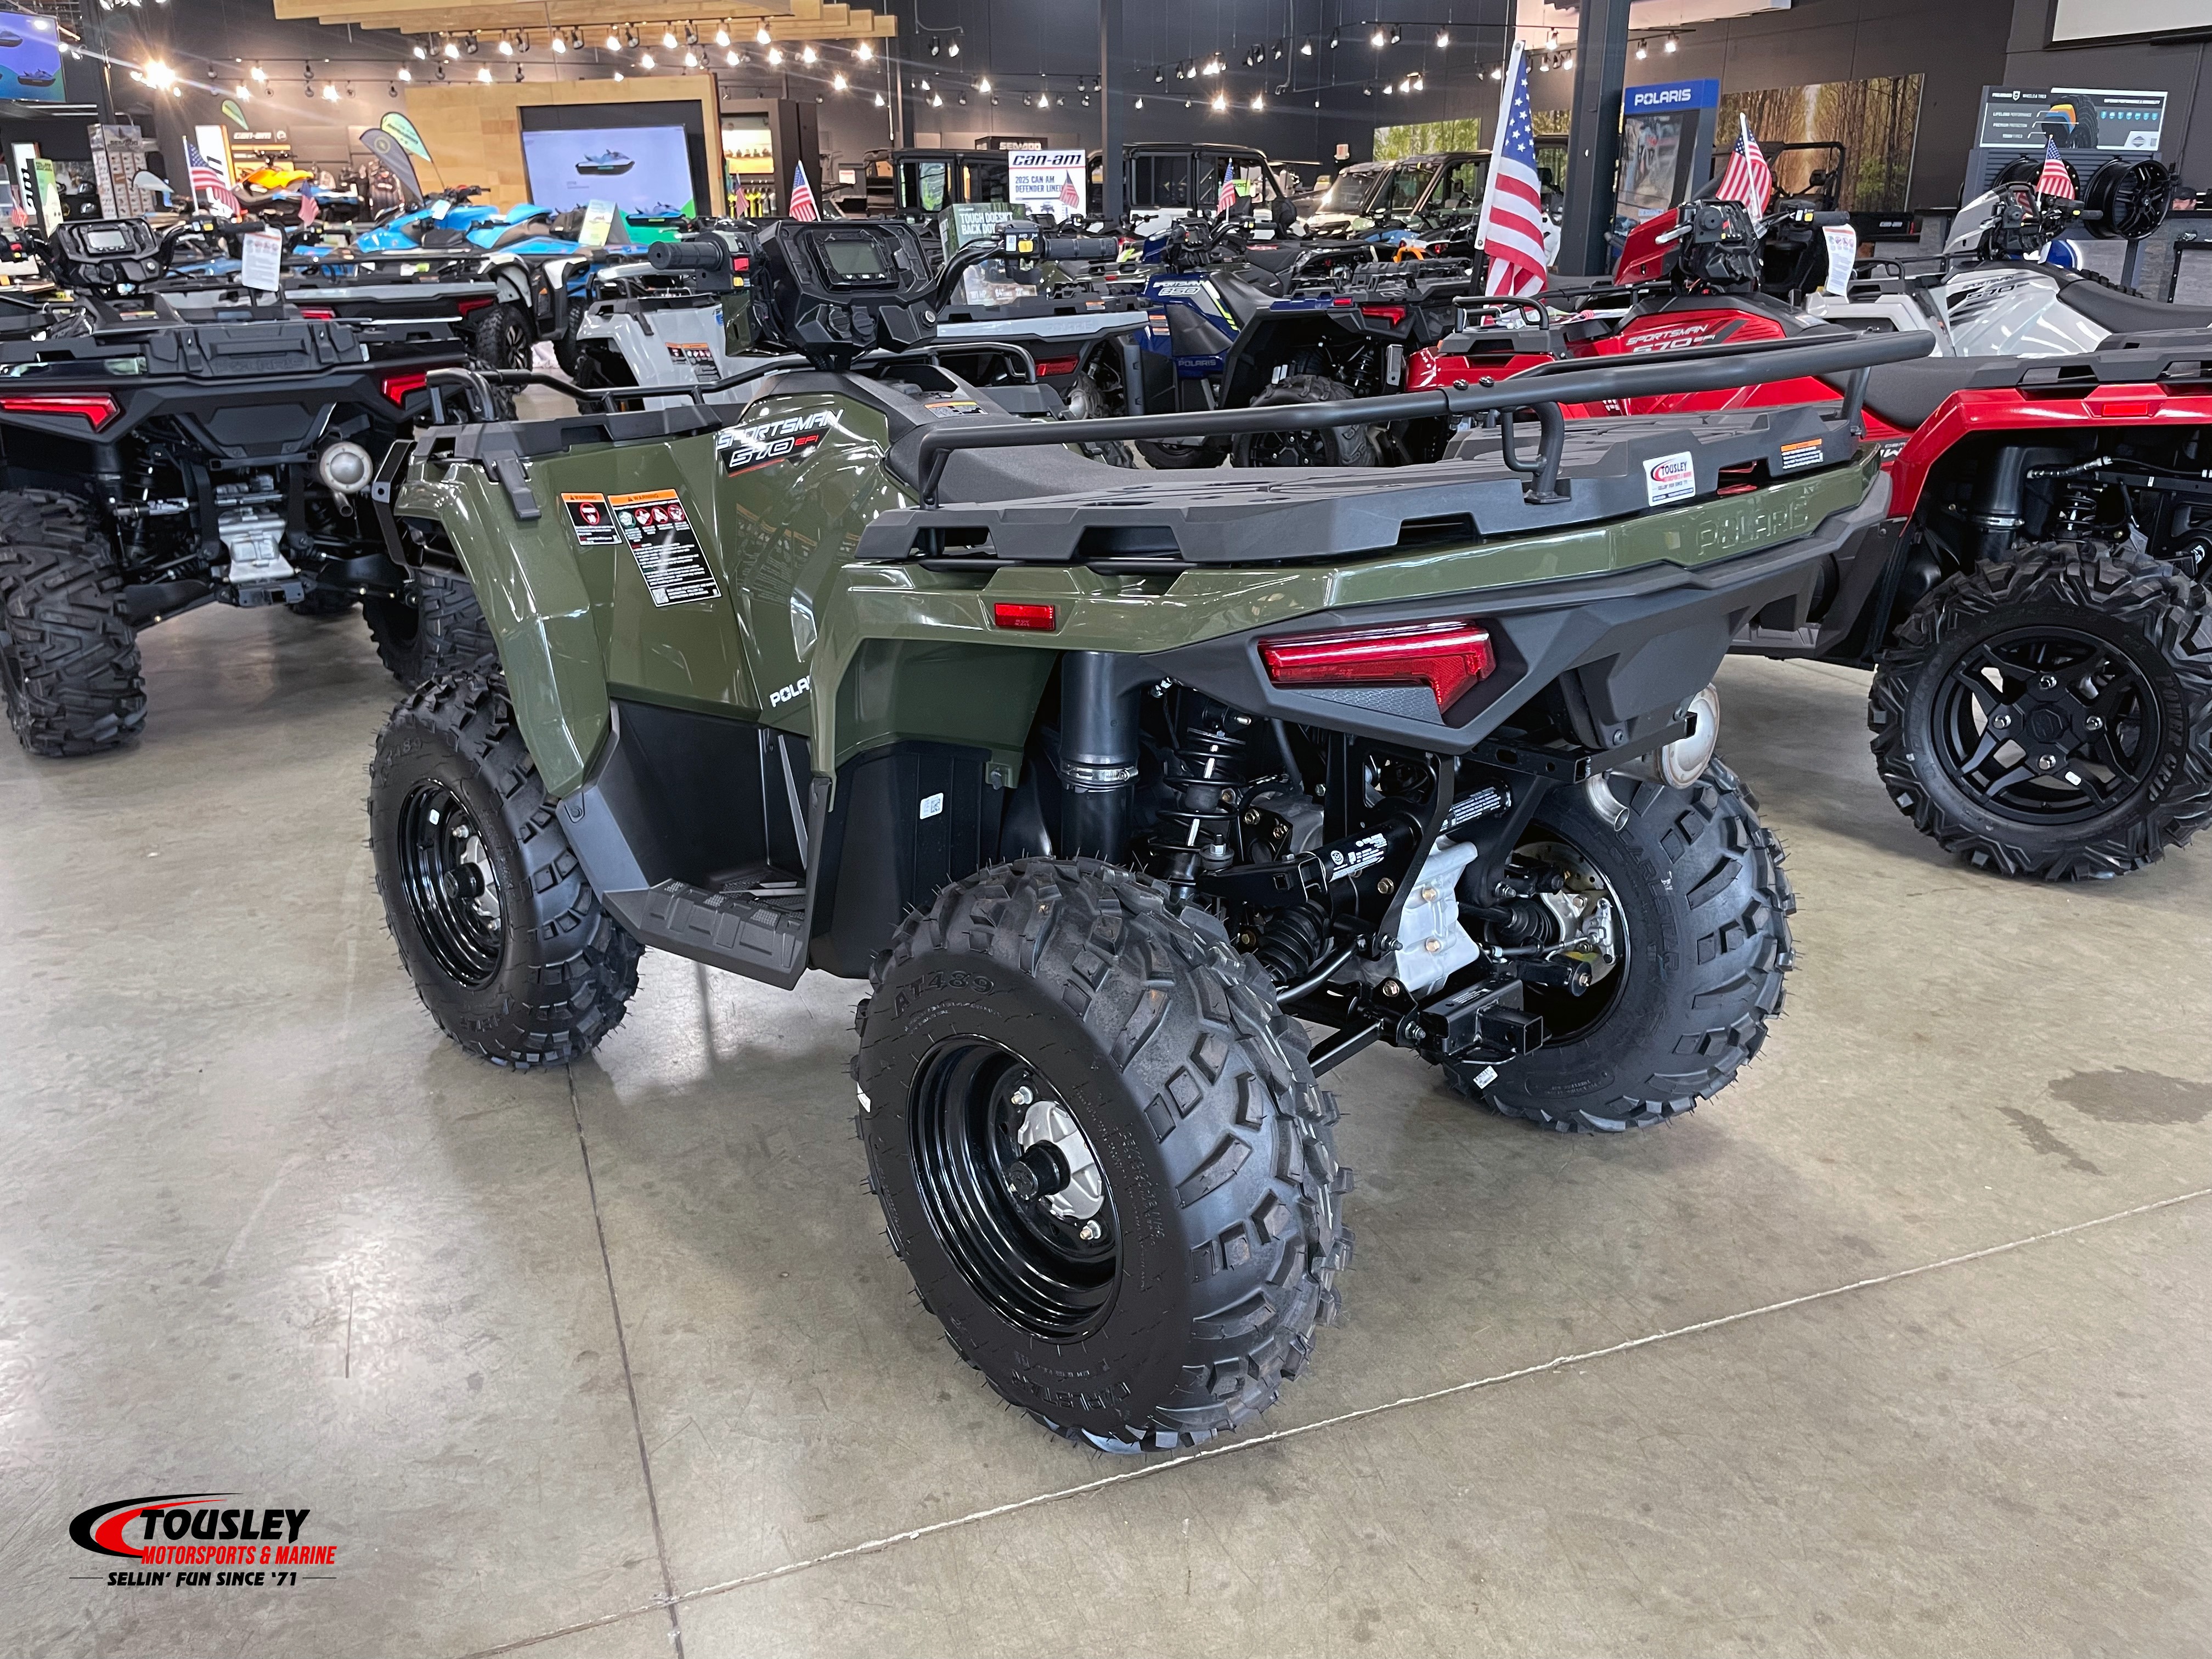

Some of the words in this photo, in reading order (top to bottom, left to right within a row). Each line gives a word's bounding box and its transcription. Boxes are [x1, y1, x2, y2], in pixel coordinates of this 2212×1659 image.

[1634, 88, 1691, 106] POLARIS
[1013, 154, 1082, 166] can-am
[960, 212, 984, 224] TOUGH
[985, 212, 1013, 223] DOESN'T
[961, 223, 981, 235] BACK
[1158, 286, 1200, 296] 850
[1626, 324, 1708, 346] SPORTSMAN
[716, 409, 845, 450] SPORTSMAN
[730, 437, 795, 467] 570
[795, 435, 819, 446] EFI
[1660, 461, 1688, 476] TOUSLEY
[770, 675, 811, 708] POLA
[1616, 828, 1680, 971] CARLSTAR
[895, 970, 995, 1017] AT489
